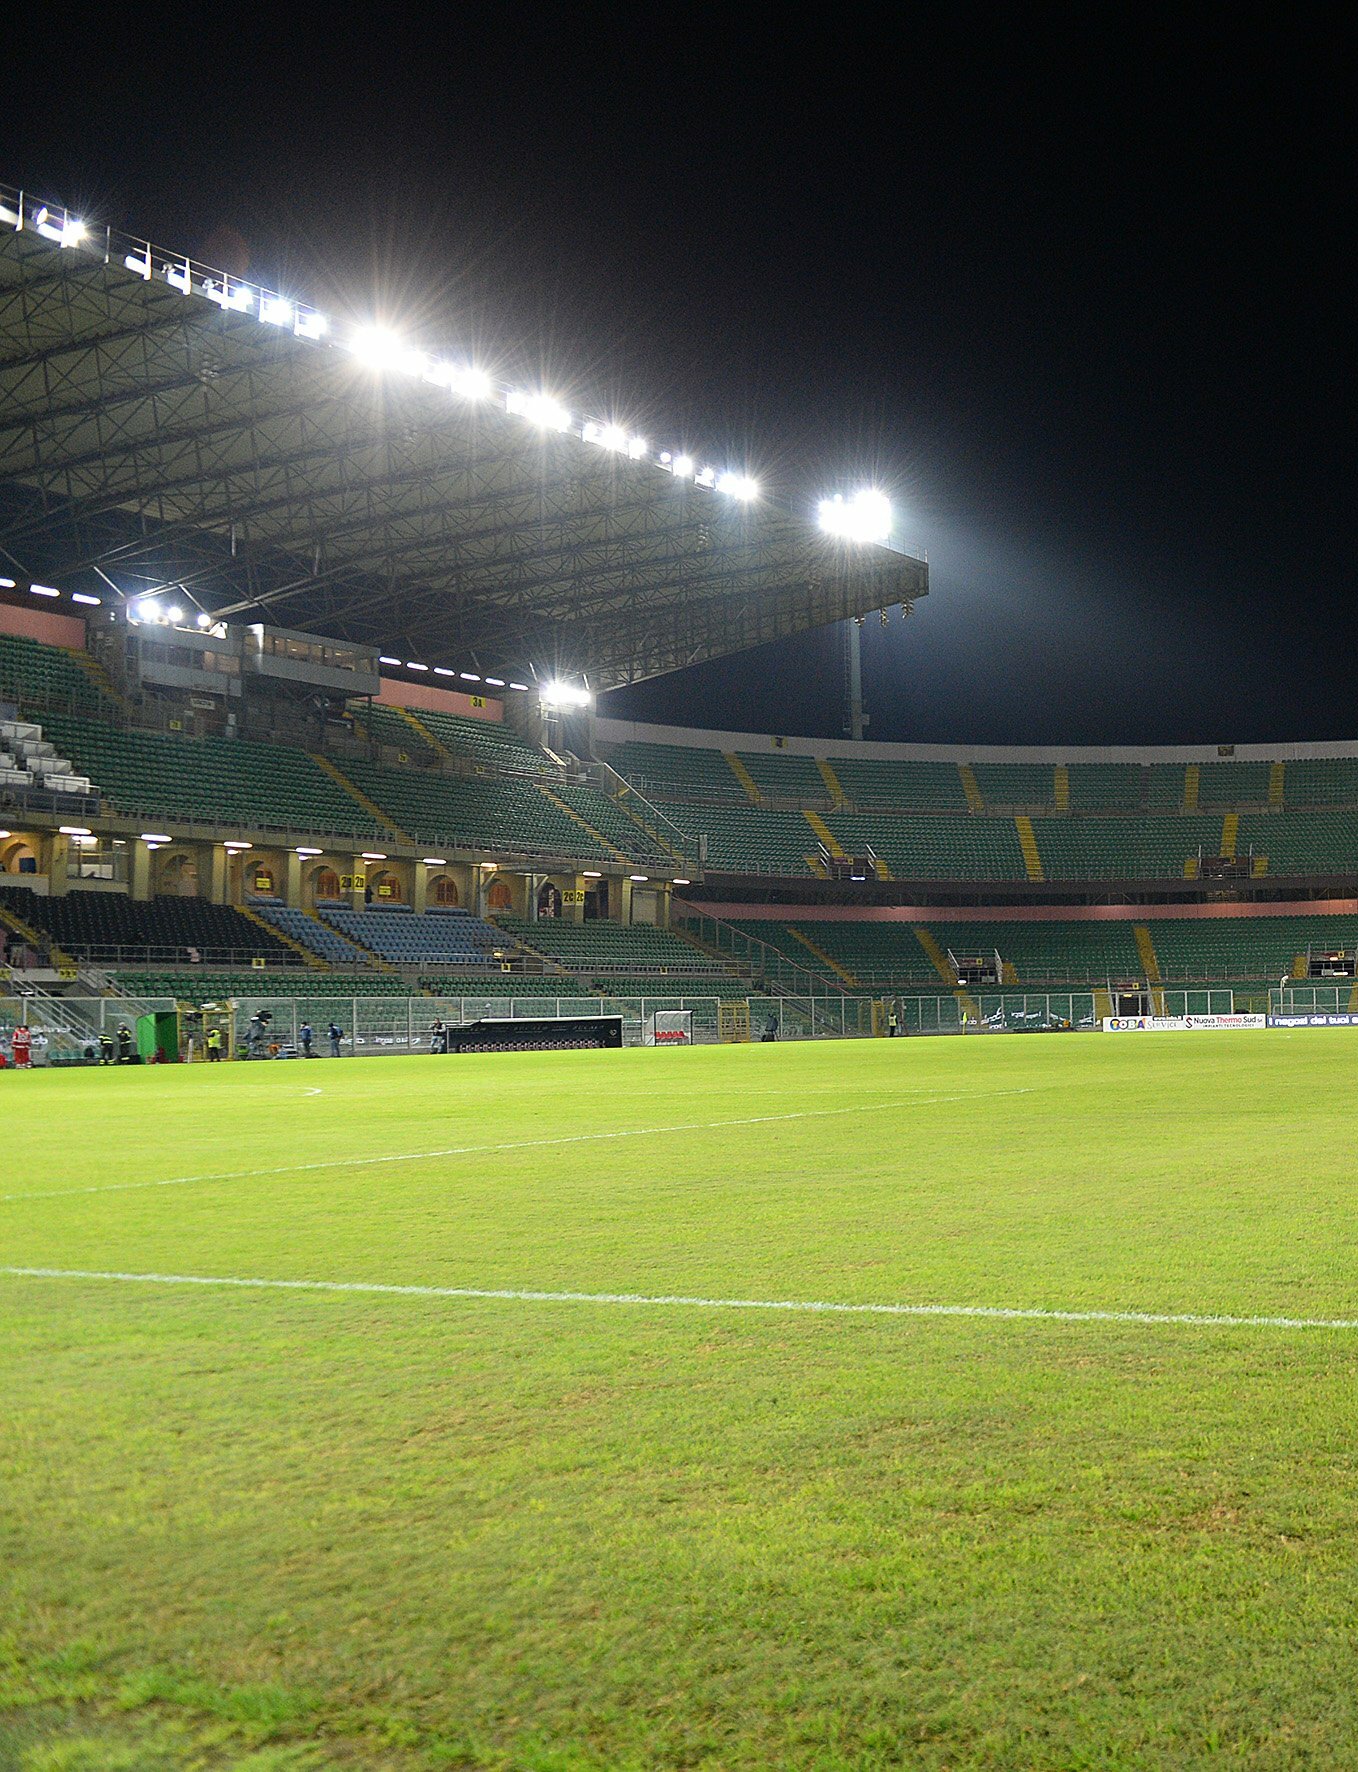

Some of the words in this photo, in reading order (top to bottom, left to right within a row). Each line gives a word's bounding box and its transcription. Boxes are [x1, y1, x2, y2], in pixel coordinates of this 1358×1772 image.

[1274, 1016, 1308, 1028] negozi
[1310, 1015, 1327, 1025] dei
[1328, 1014, 1350, 1025] tuoi
